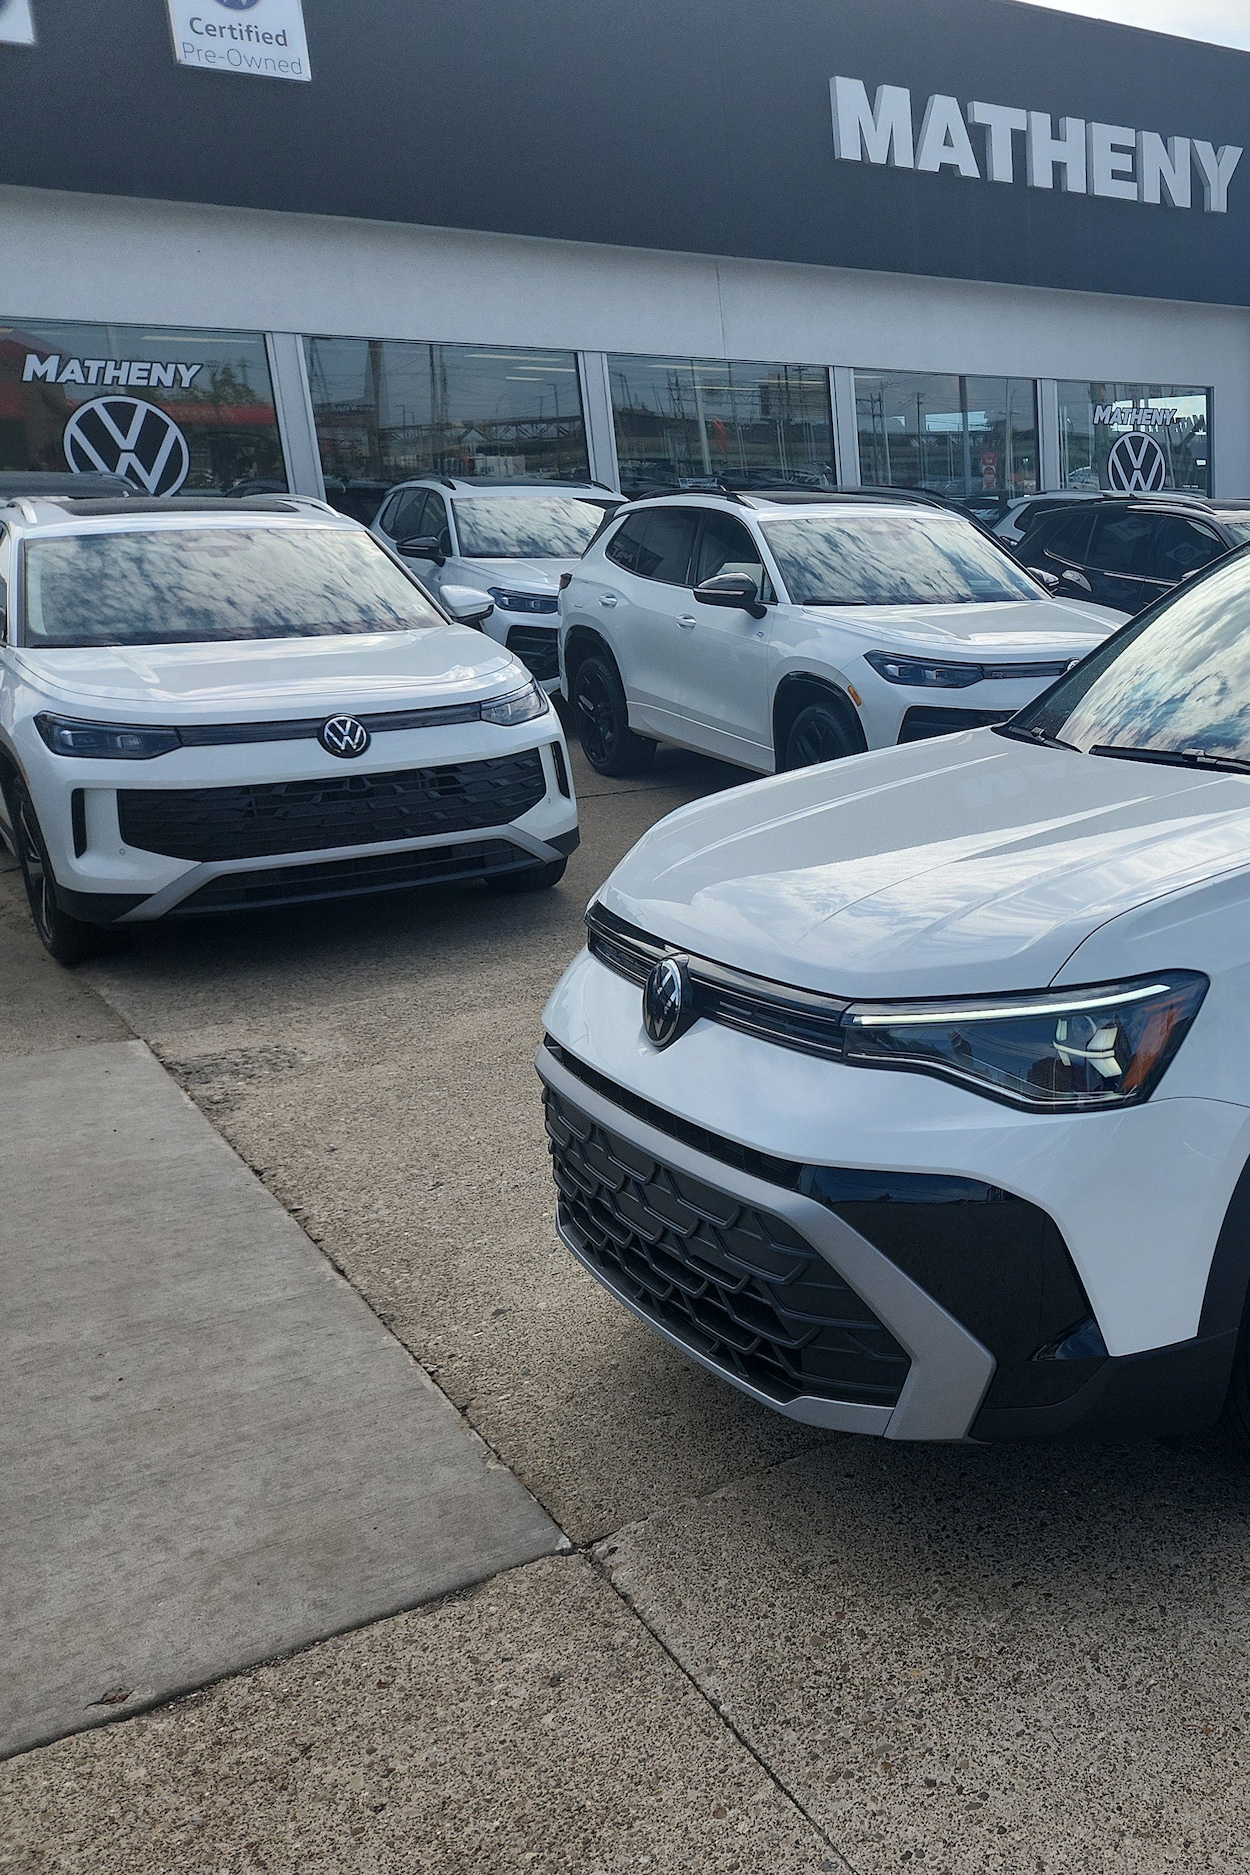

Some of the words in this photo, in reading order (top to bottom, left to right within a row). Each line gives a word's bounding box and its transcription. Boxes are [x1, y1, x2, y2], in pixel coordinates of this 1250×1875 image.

[189, 17, 288, 47] Certified
[182, 42, 302, 75] Pre-Owned
[829, 75, 1243, 214] MATHENY
[21, 353, 204, 389] MATHENY
[1093, 404, 1178, 426] MATHENY
